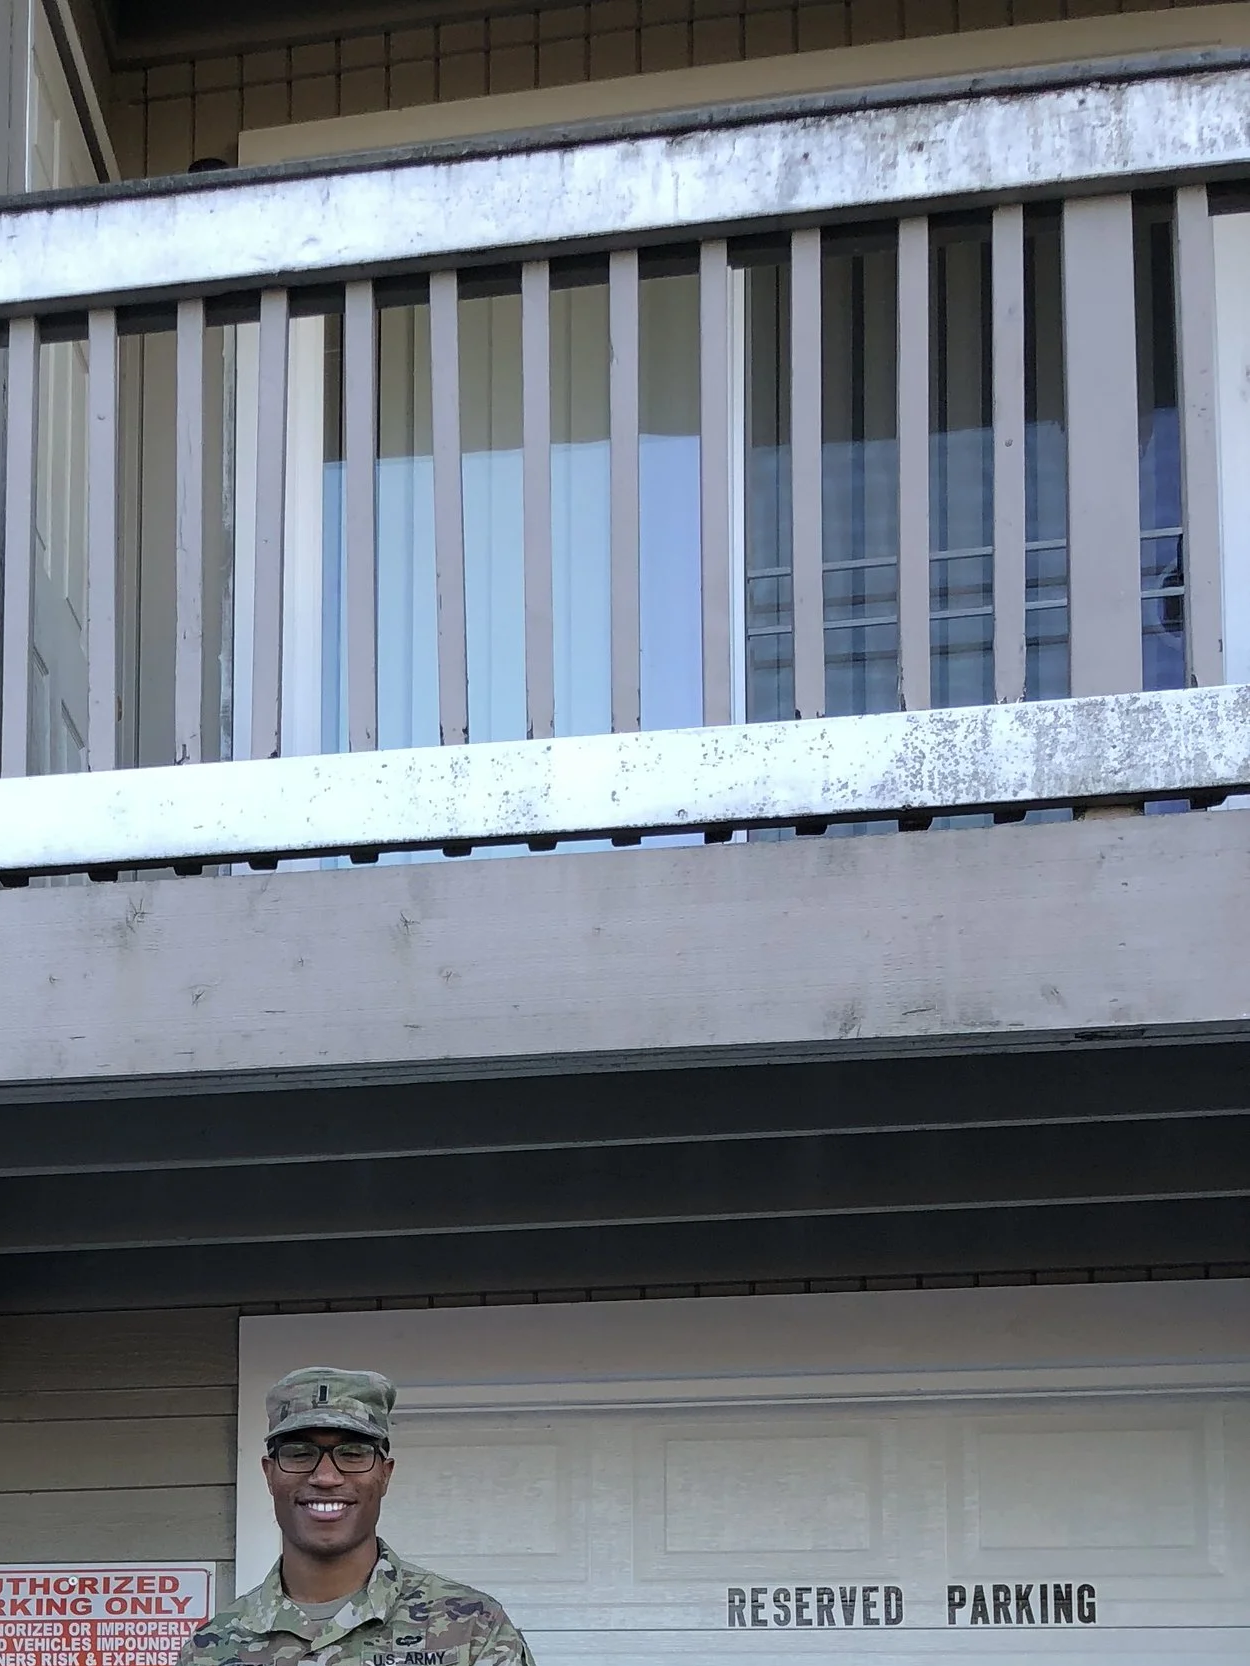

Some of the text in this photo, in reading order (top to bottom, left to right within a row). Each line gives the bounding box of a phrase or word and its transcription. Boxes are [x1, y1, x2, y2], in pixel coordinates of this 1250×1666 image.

[105, 1597, 193, 1614] ONLY
[727, 1583, 1097, 1627] RESERVED PARKING
[69, 1622, 91, 1636] OR
[97, 1621, 198, 1636] IMPROPERLY
[13, 1637, 92, 1652] VEHICLES
[41, 1652, 79, 1666] RISK
[85, 1652, 97, 1666] &
[102, 1651, 178, 1666] EXPENSE
[373, 1651, 446, 1666] U.S. ARMY
